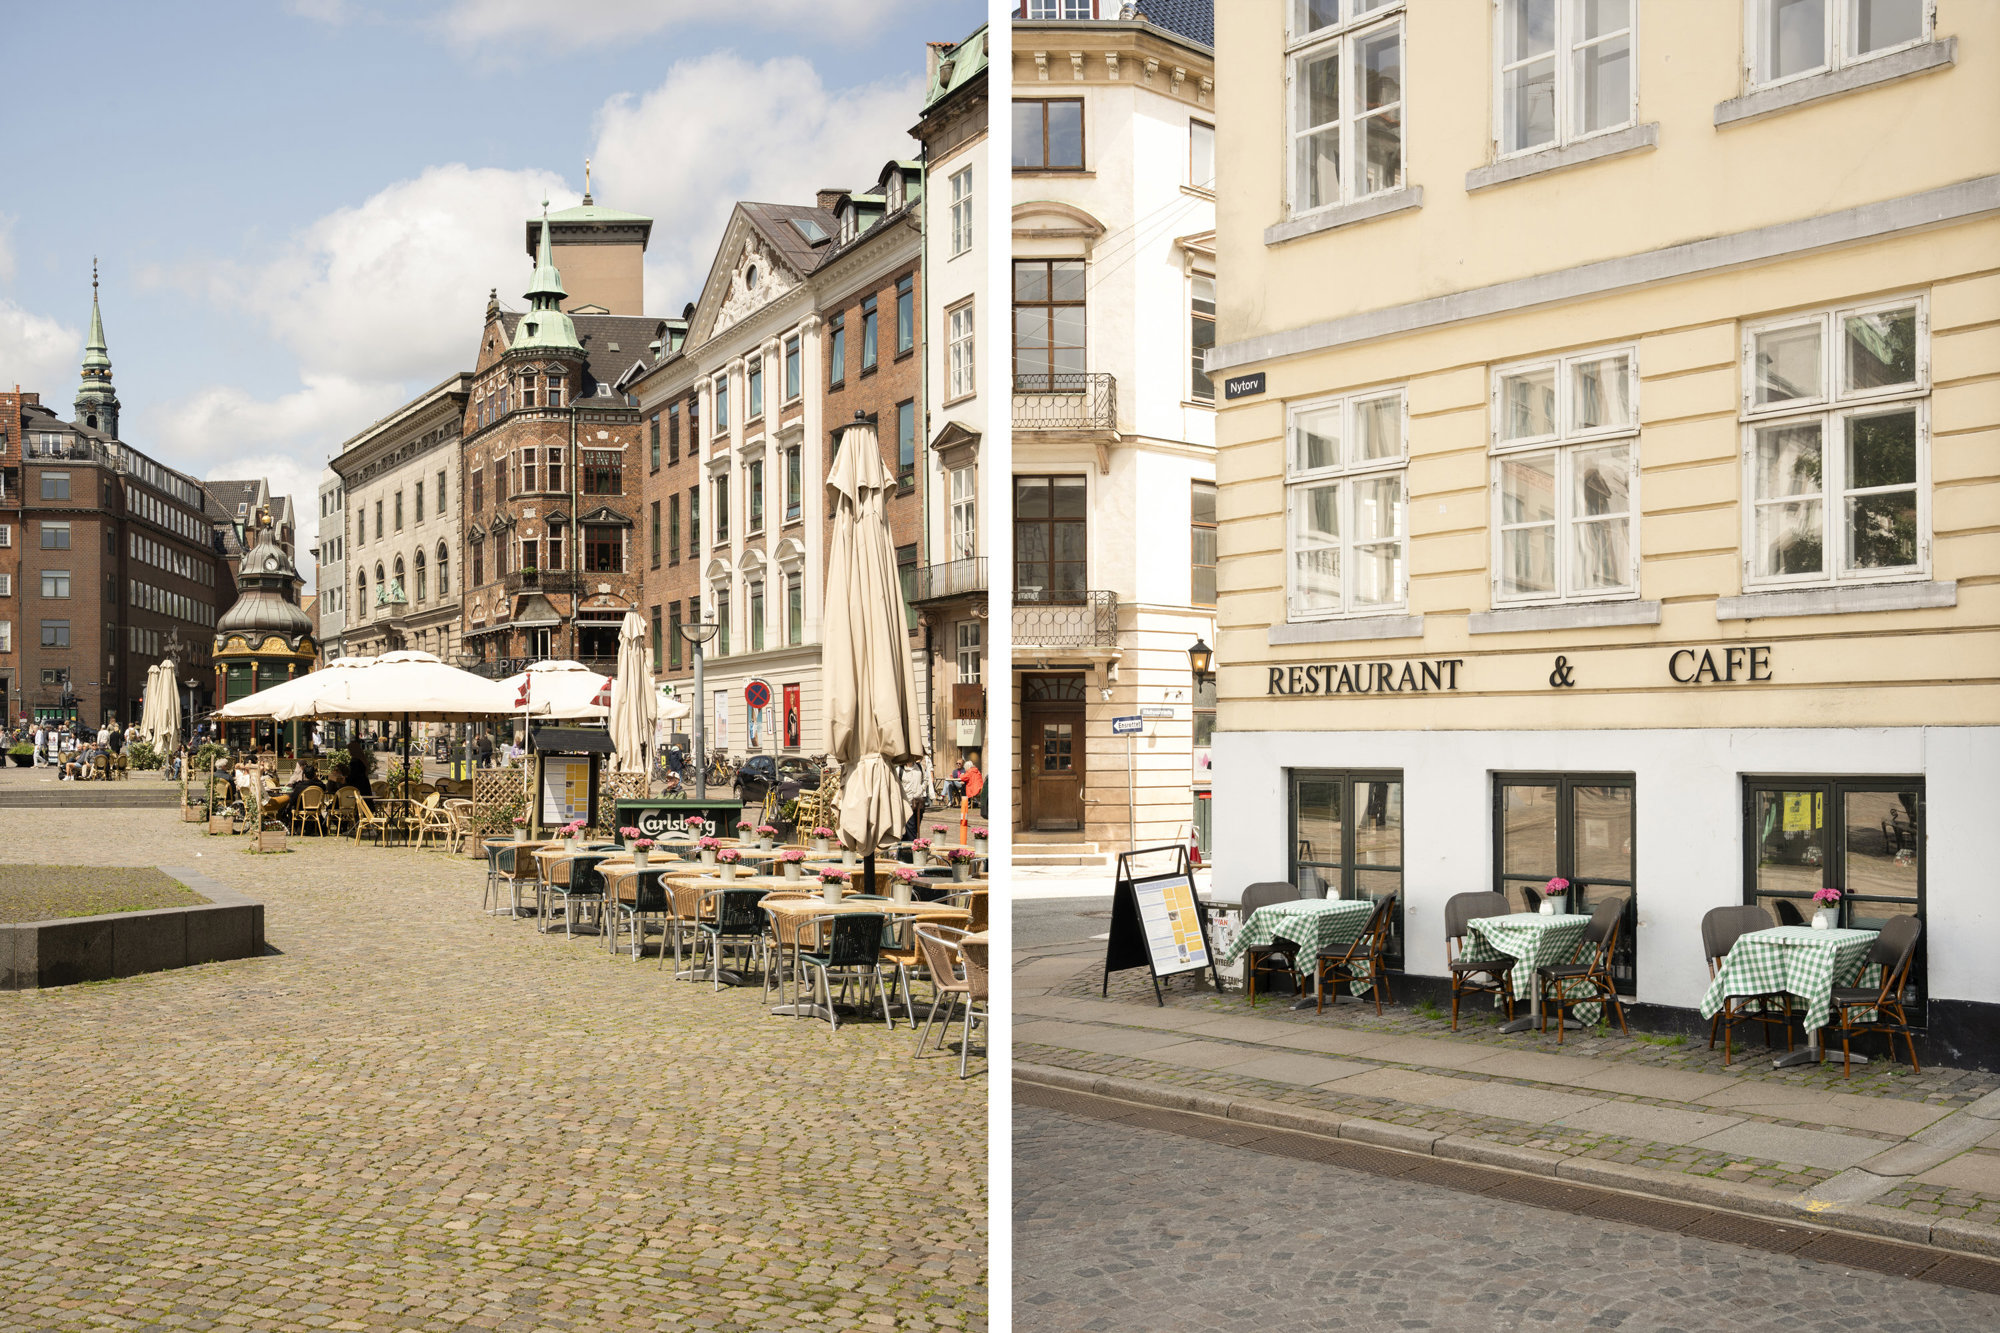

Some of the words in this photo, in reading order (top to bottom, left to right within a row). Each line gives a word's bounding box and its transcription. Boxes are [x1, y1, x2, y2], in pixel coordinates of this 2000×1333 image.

[1230, 380, 1259, 394] Nytorv
[499, 658, 544, 673] PIZZ
[1266, 659, 1464, 696] RESTAURANT
[1549, 655, 1575, 687] &
[1669, 646, 1773, 683] CAFE
[959, 708, 981, 718] BUKA
[638, 808, 716, 837] Carlsbrg
